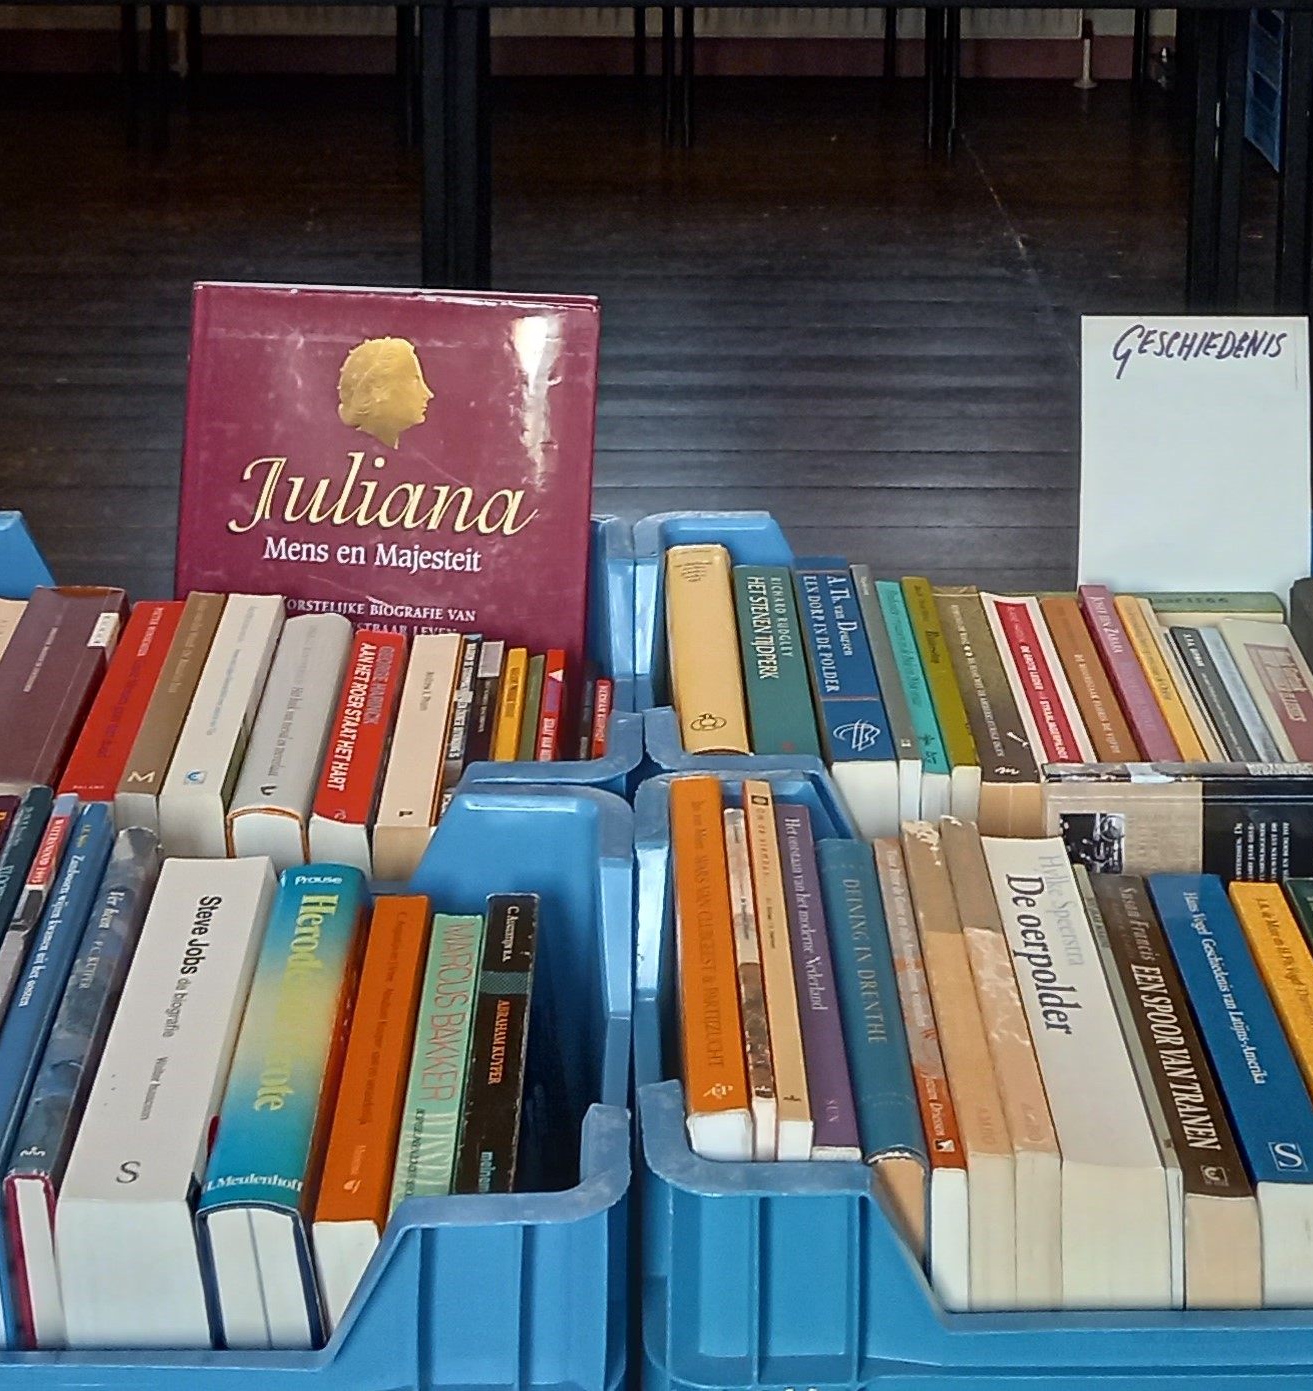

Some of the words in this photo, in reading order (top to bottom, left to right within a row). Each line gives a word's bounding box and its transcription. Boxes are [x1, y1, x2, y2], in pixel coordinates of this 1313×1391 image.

[1113, 324, 1287, 379] GESCHIEDENIS
[228, 452, 539, 536] Juliana
[263, 537, 330, 563] Mens
[336, 545, 366, 565] en
[374, 544, 483, 574] Majesteit
[746, 575, 767, 595] HET
[769, 576, 787, 614] RICHARD
[801, 575, 819, 593] EEN
[828, 588, 852, 603] Th.
[369, 601, 443, 621] BIOGRAFIE
[447, 609, 476, 622] VAN
[749, 596, 772, 633] STENEN
[805, 595, 826, 621] DORP
[832, 605, 847, 618] van
[356, 642, 377, 663] AAN
[775, 617, 793, 657] RUDGLEY
[835, 621, 864, 655] Deursen
[350, 663, 372, 682] HET
[371, 645, 395, 682] GEORGE
[750, 635, 779, 679] TIJDPERK
[817, 652, 841, 692] POLDER
[344, 682, 368, 709] ROER
[362, 682, 387, 725] HARINCK
[337, 707, 362, 740] STAAT
[332, 738, 355, 761] HET
[325, 760, 350, 792] HART
[784, 818, 802, 834] Het
[786, 836, 807, 873] ontstaan
[295, 875, 343, 886] Prause
[791, 874, 809, 892] van
[1029, 854, 1074, 896] Hylke
[188, 895, 223, 935] Steve
[793, 893, 812, 909] het
[1116, 886, 1146, 917] Susan
[1181, 892, 1204, 912] Hans
[795, 910, 818, 953] moderne
[1042, 900, 1095, 966] Speerstra
[1127, 920, 1161, 961] Francis
[1185, 913, 1212, 934] Vogel
[177, 938, 211, 974] Jobs
[430, 921, 477, 1009] MARCUS
[842, 878, 870, 940] DEINING
[856, 969, 887, 1043] DRENTHE
[1002, 914, 1089, 1035] oerpolder
[1198, 937, 1234, 991] Geschiedenis
[803, 956, 827, 1010] Nederland
[1130, 964, 1168, 993] EEN
[156, 993, 188, 1038] biografie
[1139, 994, 1186, 1045] SPOOR
[1219, 993, 1241, 1009] van
[490, 999, 510, 1045] ABRAHAM
[417, 1011, 467, 1102] BAKKER
[486, 1047, 506, 1084] KUYPER
[1156, 1047, 1197, 1079] VAN
[1222, 1011, 1270, 1084] Latijns-Amerika
[1167, 1081, 1221, 1150] TRANEN
